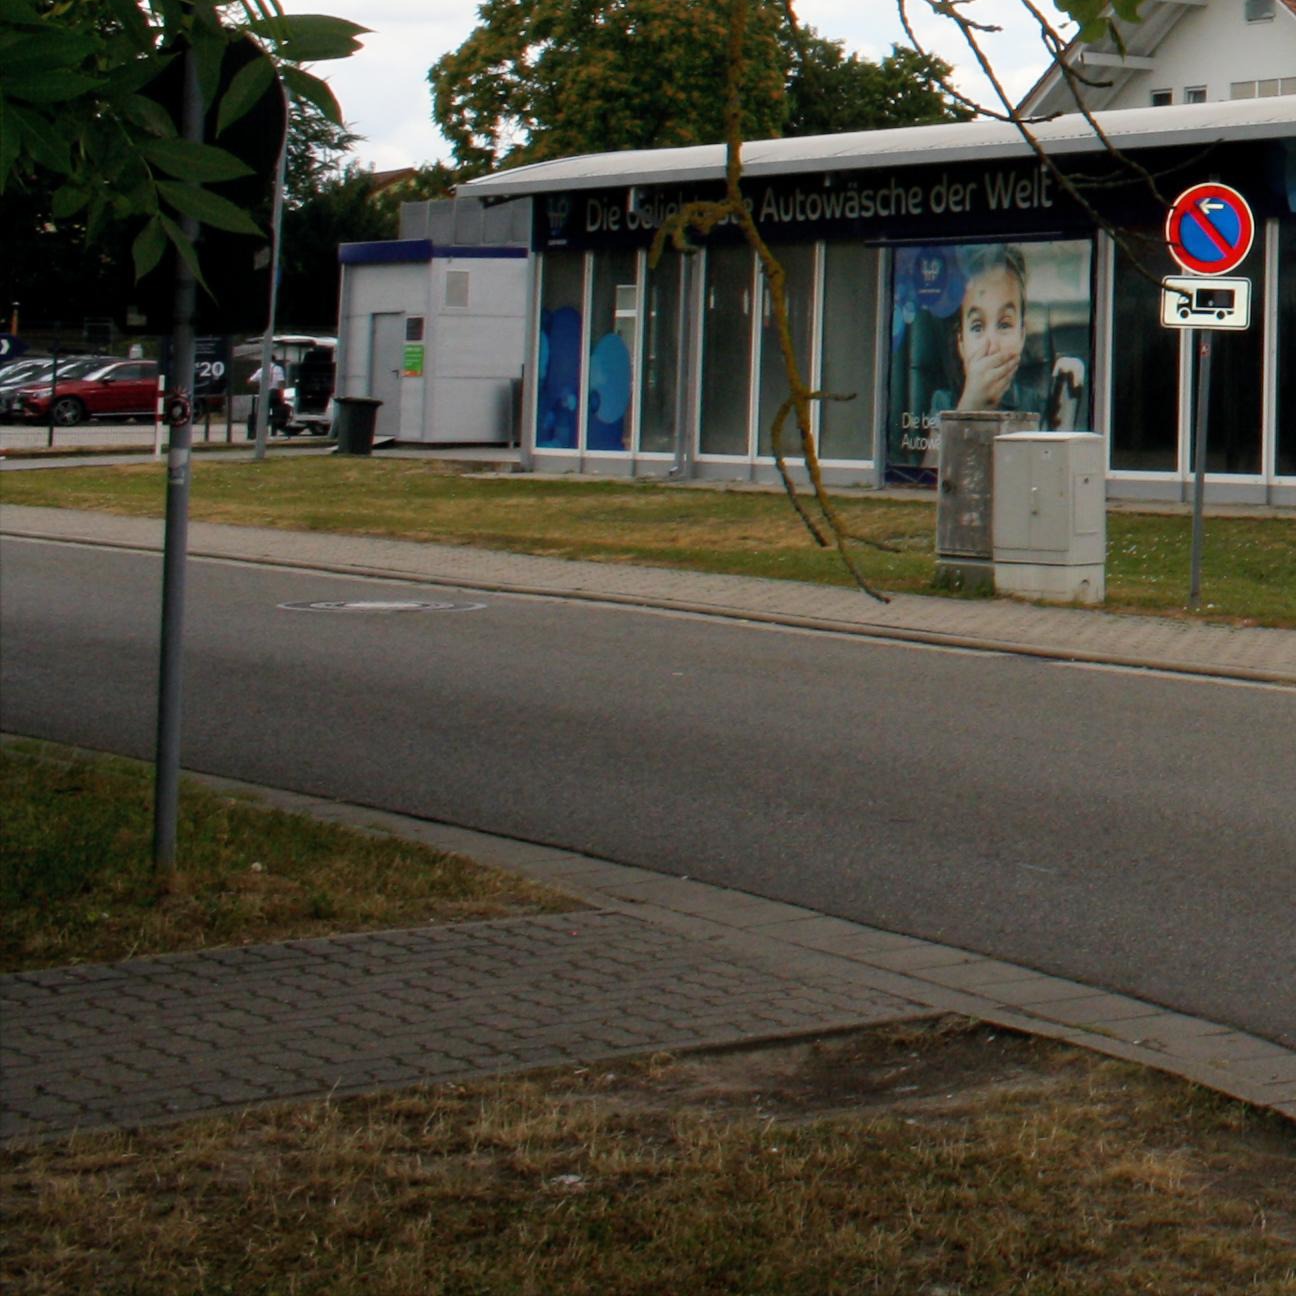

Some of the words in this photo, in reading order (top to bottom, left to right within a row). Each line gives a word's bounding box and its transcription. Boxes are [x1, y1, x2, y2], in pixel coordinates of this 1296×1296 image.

[586, 195, 619, 231] Die
[760, 177, 922, 222] Autowäsche
[931, 171, 976, 213] der
[984, 168, 1053, 210] Welt
[902, 411, 920, 429] Die
